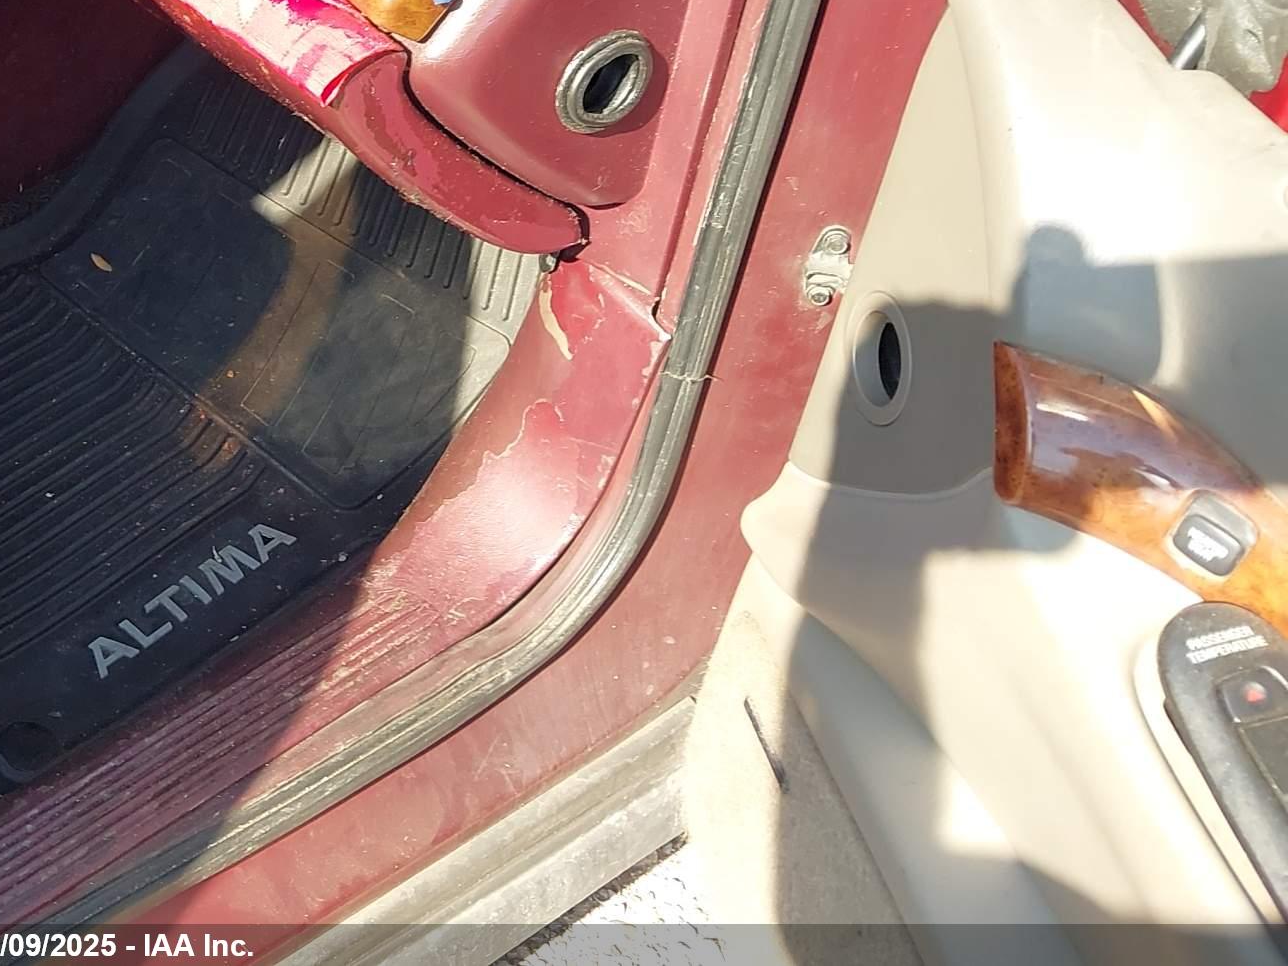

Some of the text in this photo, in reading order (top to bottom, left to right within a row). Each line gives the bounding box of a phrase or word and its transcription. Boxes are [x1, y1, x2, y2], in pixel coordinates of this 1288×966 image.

[87, 523, 297, 679] ALTIMA
[1185, 625, 1255, 651] PASSENGER
[1185, 635, 1269, 664] TEMPERATURE
